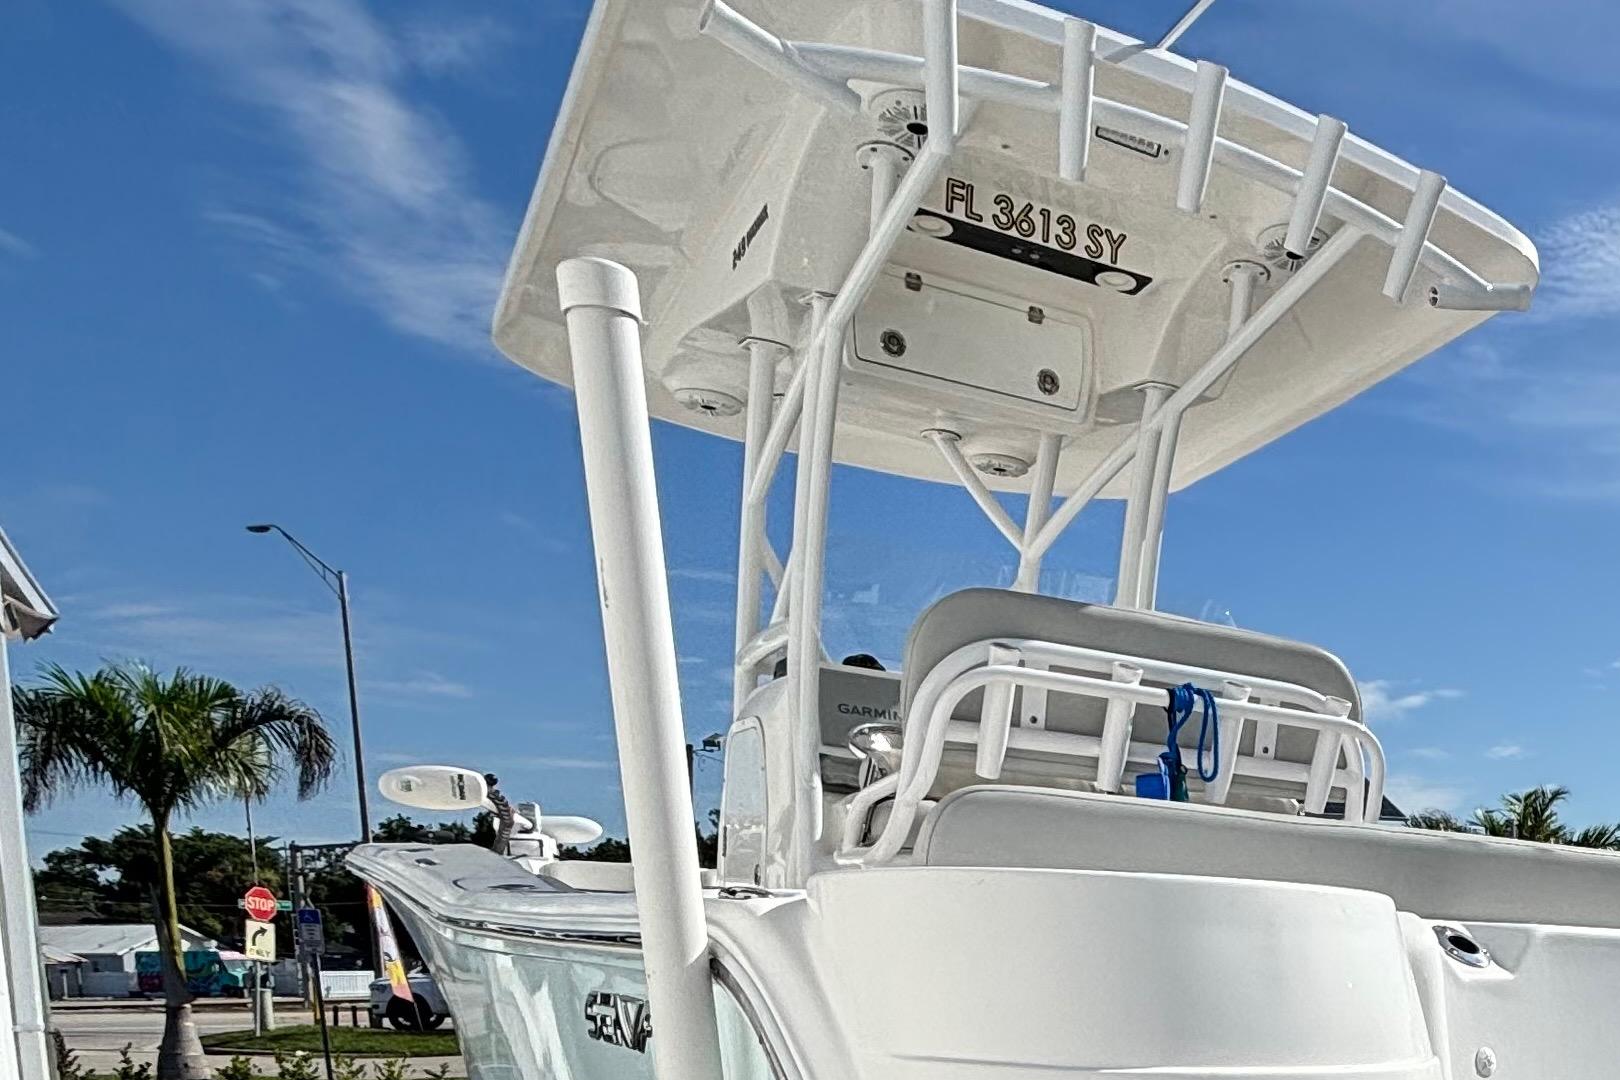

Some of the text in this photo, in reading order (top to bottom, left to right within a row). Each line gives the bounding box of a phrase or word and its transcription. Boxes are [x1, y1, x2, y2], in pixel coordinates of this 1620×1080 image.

[945, 178, 1126, 264] FL 3613 SY
[247, 896, 274, 912] STOP
